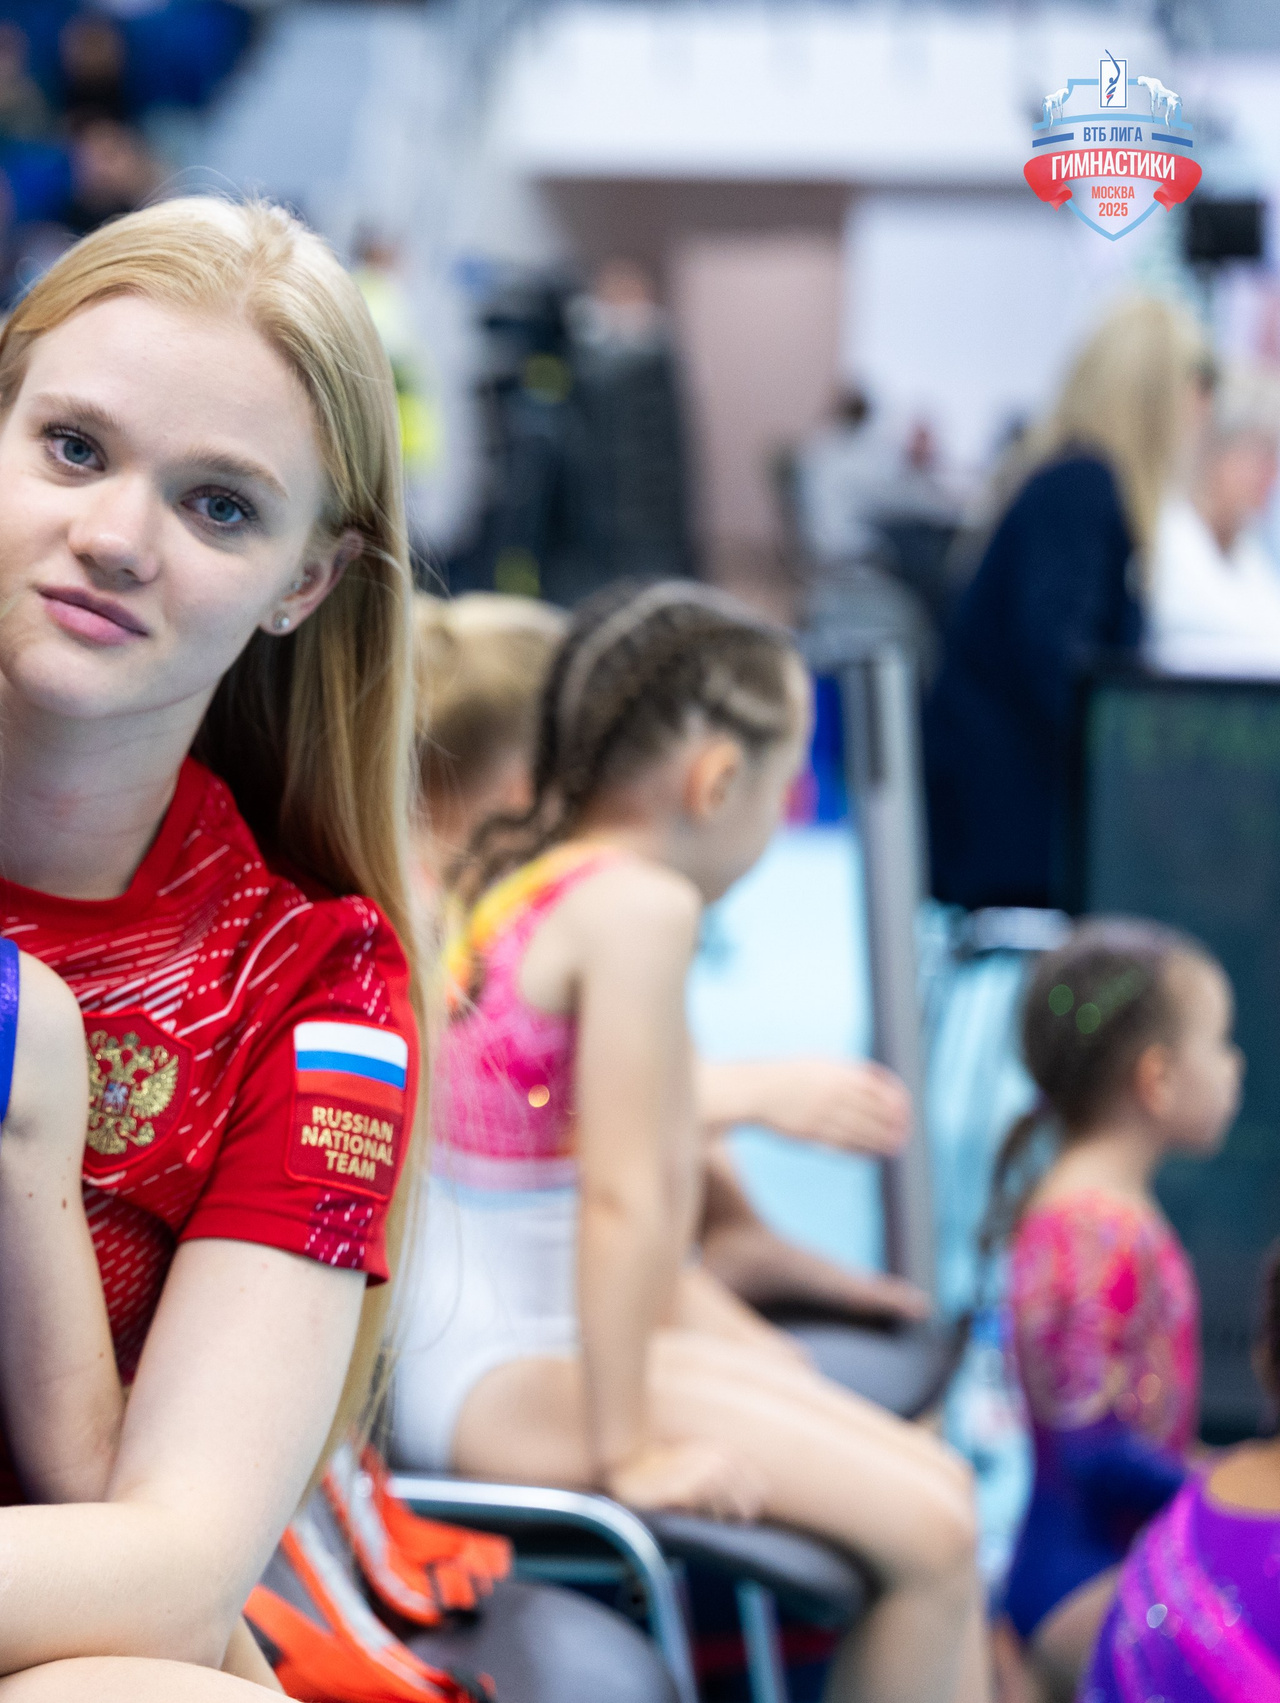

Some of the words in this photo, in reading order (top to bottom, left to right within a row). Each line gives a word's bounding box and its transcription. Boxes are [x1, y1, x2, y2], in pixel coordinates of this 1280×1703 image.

[312, 1106, 394, 1143] RUSSIAN
[301, 1125, 394, 1166] NATIONAL
[325, 1150, 376, 1181] TEAM
